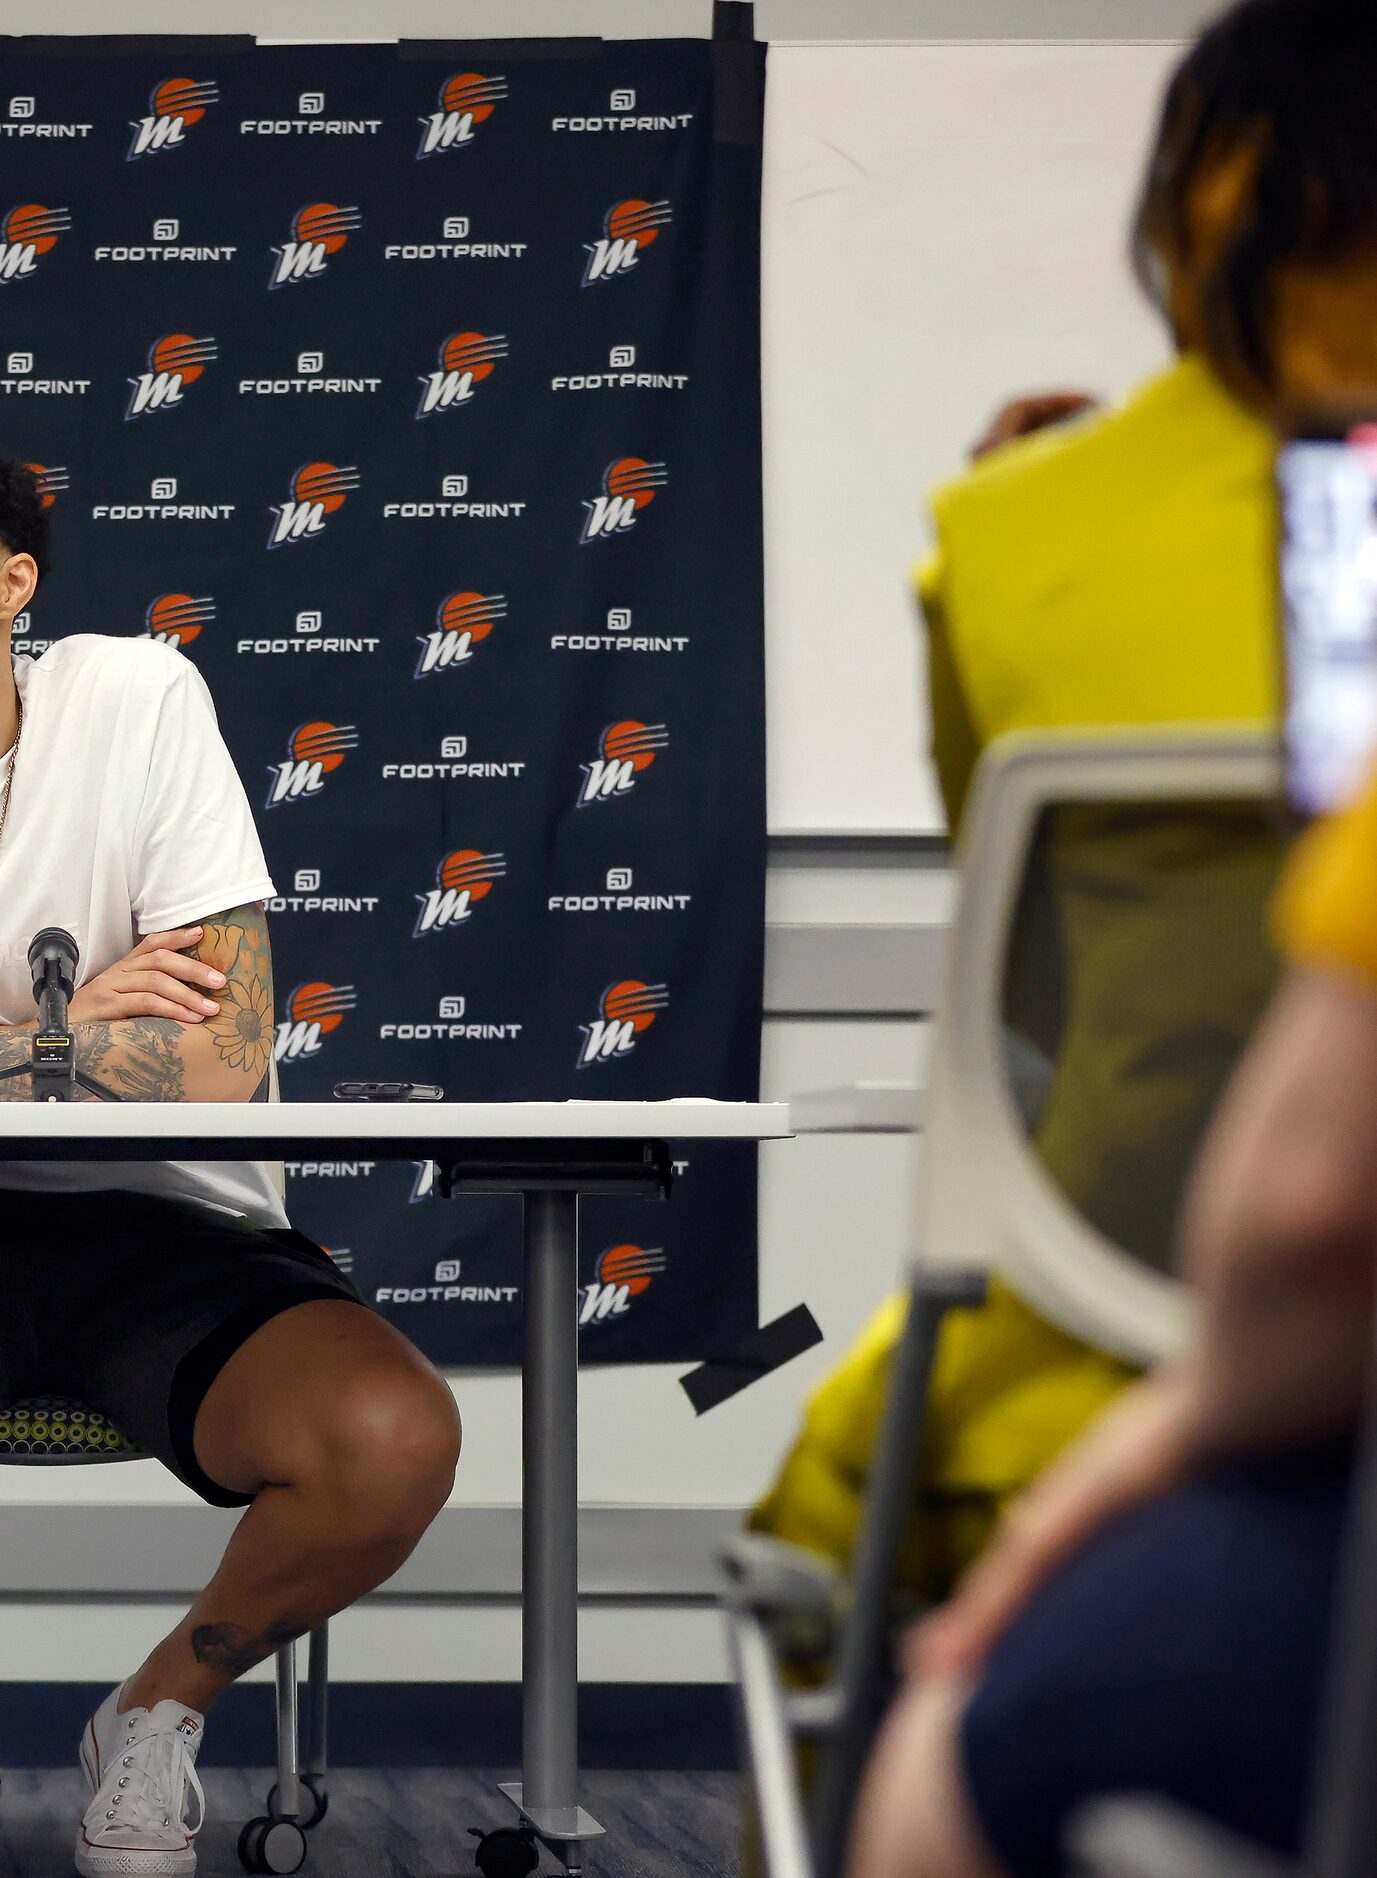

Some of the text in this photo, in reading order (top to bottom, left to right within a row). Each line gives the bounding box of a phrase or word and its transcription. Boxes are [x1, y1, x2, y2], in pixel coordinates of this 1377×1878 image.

[240, 120, 382, 135] FOOTPRINT
[552, 114, 693, 132] FOOTPRINT
[94, 246, 237, 261] FOOTPRINT
[385, 243, 527, 260] FOOTPRINT
[239, 378, 382, 394] FOOTPRINT
[551, 373, 689, 391] FOOTPRINT
[92, 505, 236, 520] FOOTPRINT
[383, 502, 526, 518] FOOTPRINT
[237, 638, 380, 654] FOOTPRINT
[550, 635, 689, 652] FOOTPRINT
[382, 762, 525, 779] FOOTPRINT
[262, 896, 380, 913] OTPRINT
[548, 895, 691, 911] FOOTPRINT
[380, 1024, 522, 1039] FOOTPRINT
[285, 1161, 377, 1178] TPRINT
[375, 1286, 518, 1303] FOOTPRINT
